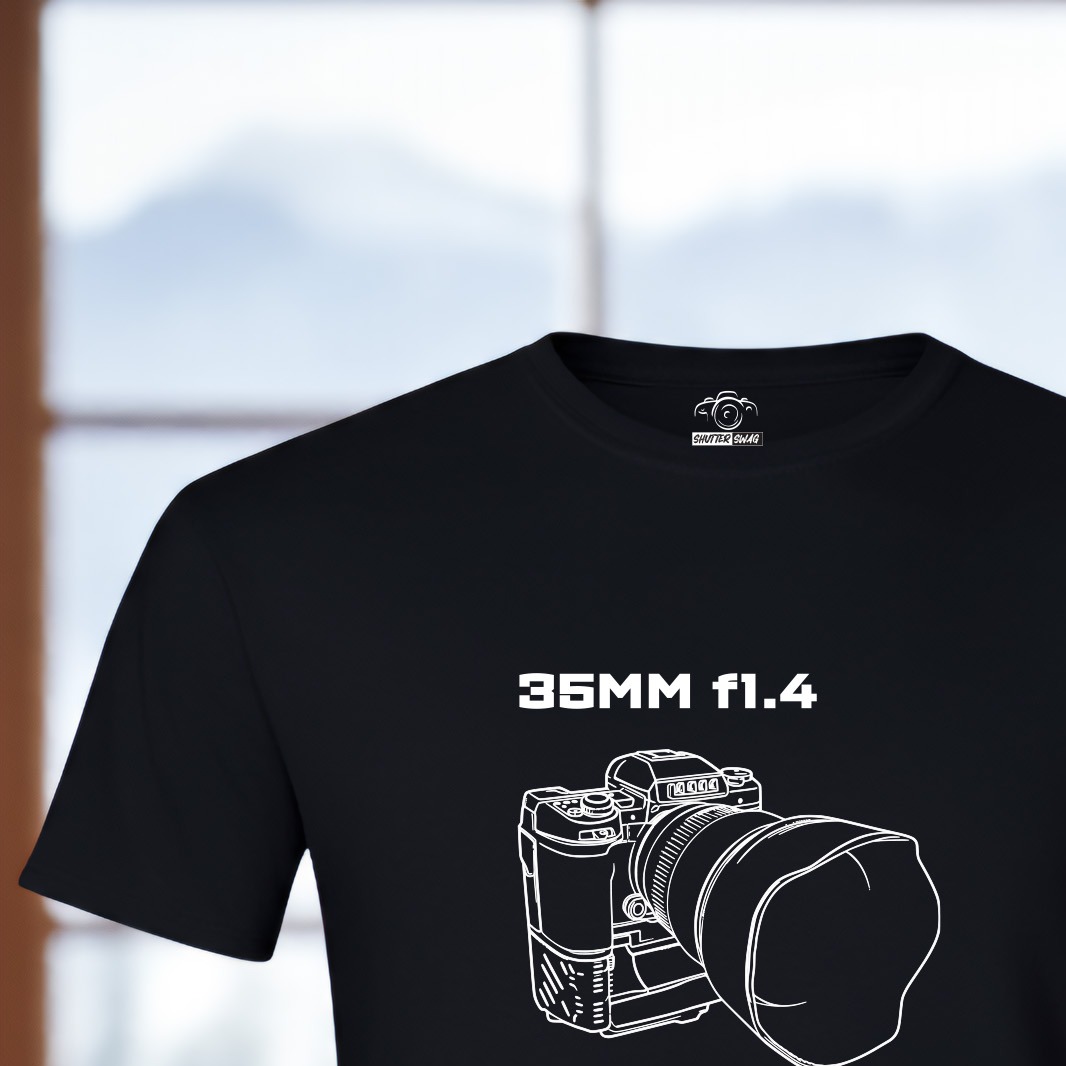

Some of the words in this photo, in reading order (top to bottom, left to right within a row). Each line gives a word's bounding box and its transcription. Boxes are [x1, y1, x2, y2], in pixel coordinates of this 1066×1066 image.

[693, 433, 732, 444] SHUTTER
[733, 433, 760, 444] SWAG
[518, 672, 691, 710] 35MM
[711, 672, 818, 709] f1.4
